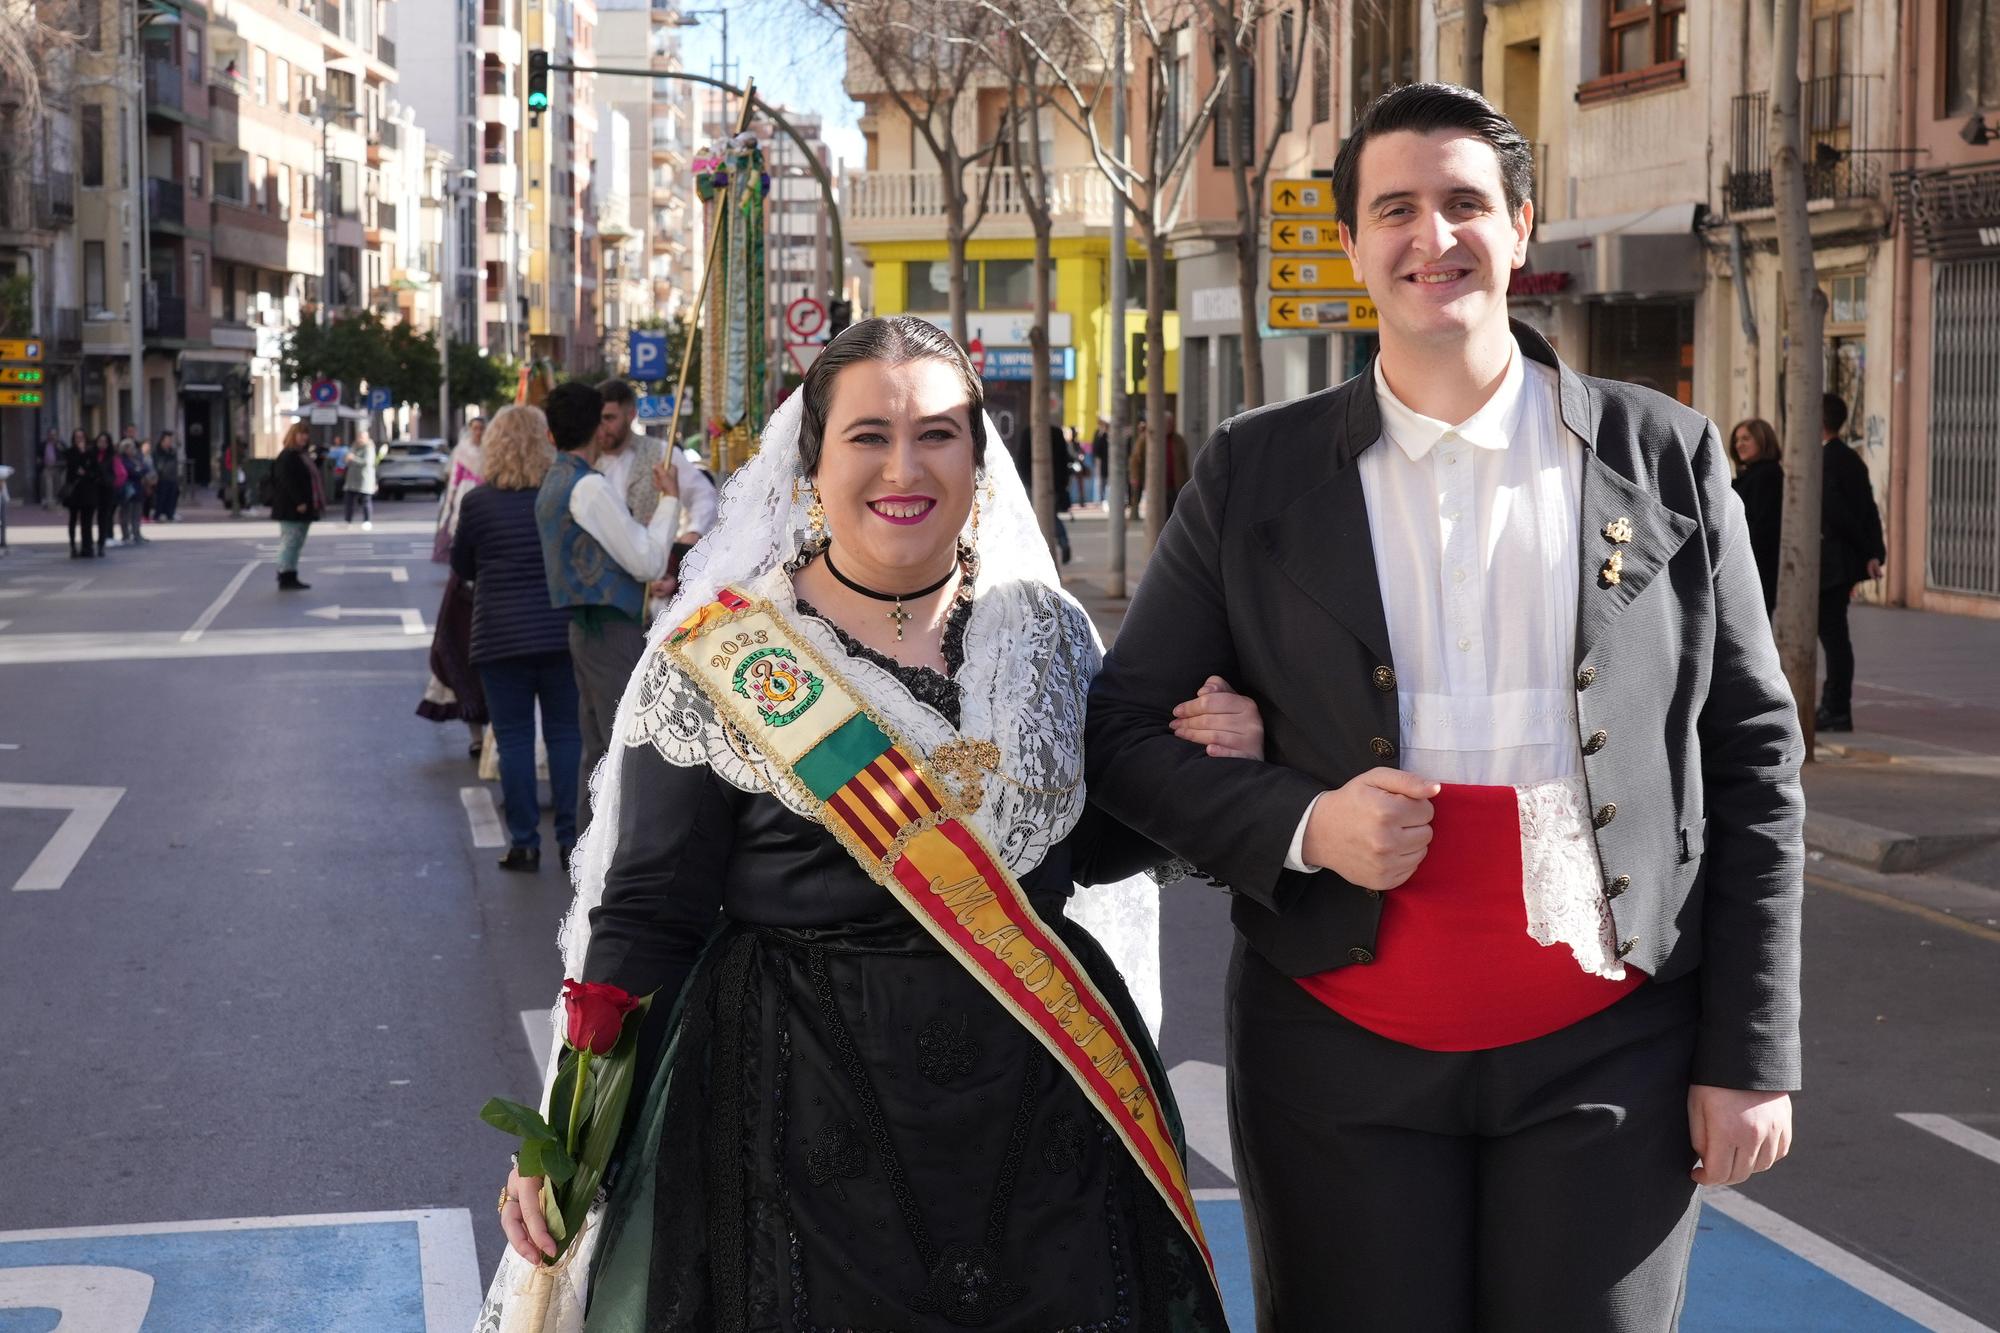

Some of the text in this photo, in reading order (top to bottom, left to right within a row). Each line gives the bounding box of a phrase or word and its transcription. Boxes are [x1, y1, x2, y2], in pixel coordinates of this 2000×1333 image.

[636, 342, 658, 369] P
[711, 629, 768, 671] 2023
[929, 874, 1149, 1122] MADRINA
